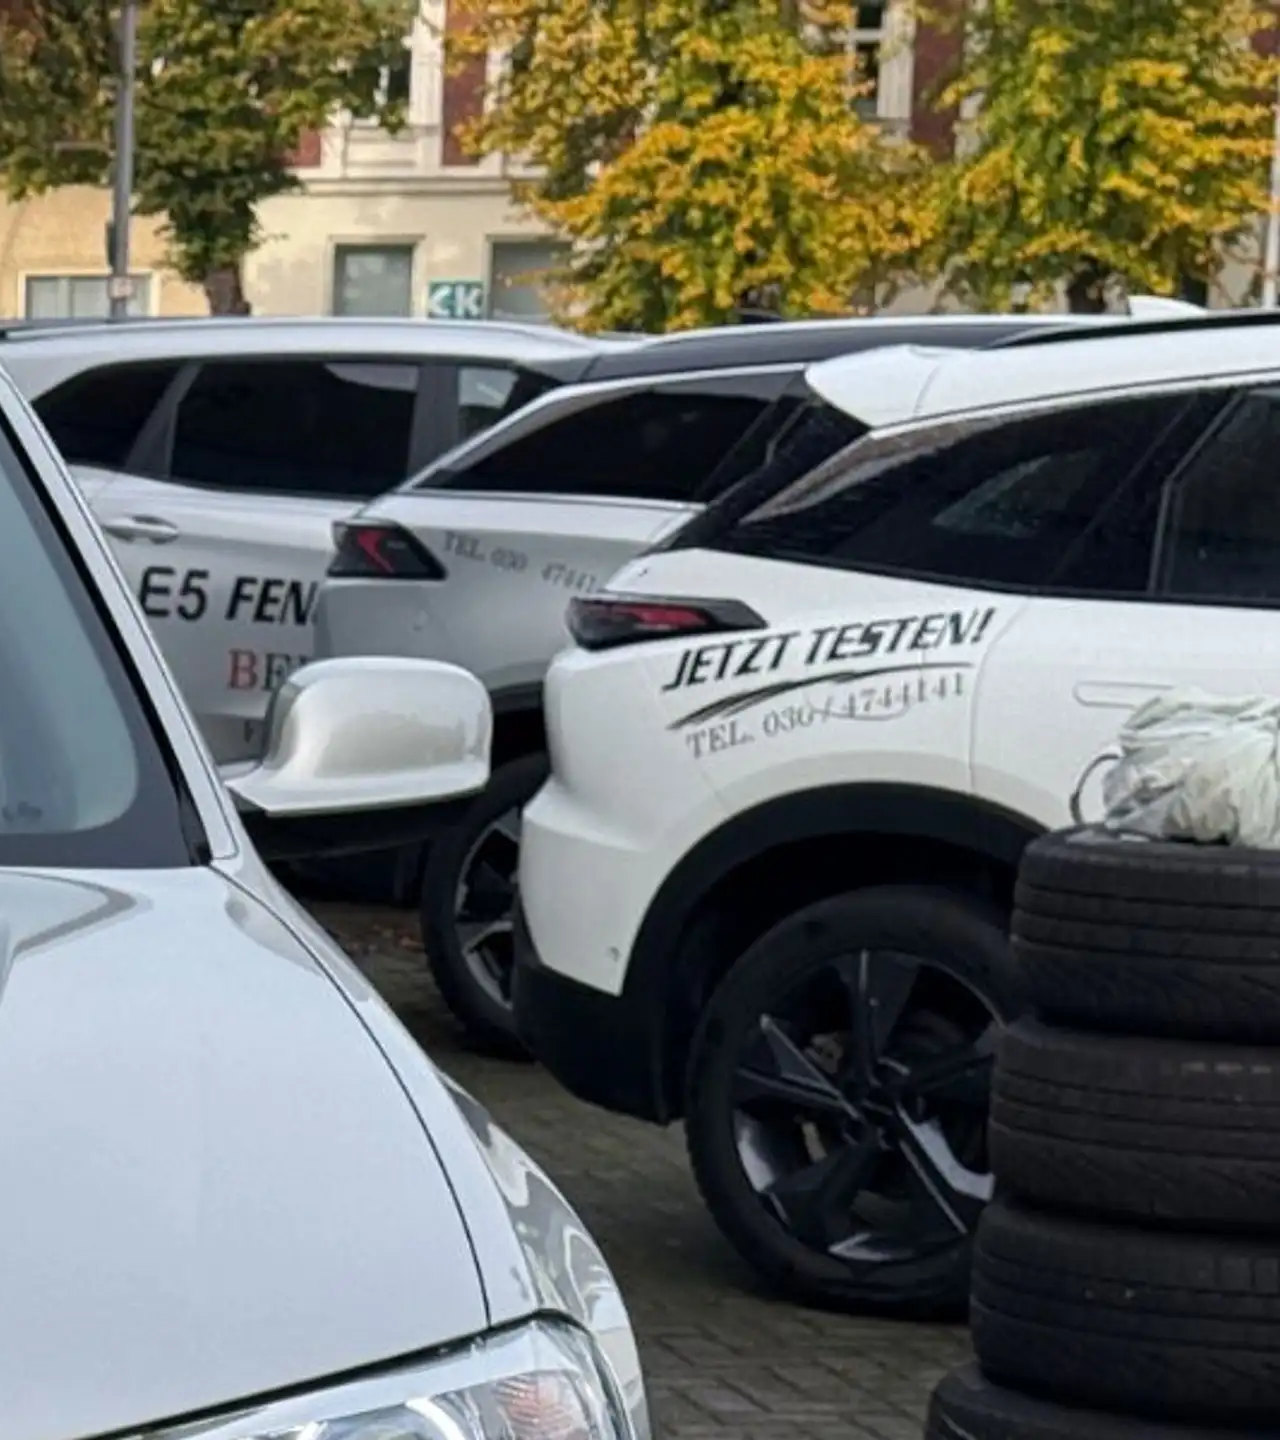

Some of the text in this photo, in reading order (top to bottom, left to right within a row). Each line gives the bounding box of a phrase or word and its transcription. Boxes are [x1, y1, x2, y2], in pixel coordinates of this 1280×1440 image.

[225, 576, 319, 626] FEN
[660, 606, 997, 692] JETZT TESTEN!
[685, 719, 756, 760] TEL.
